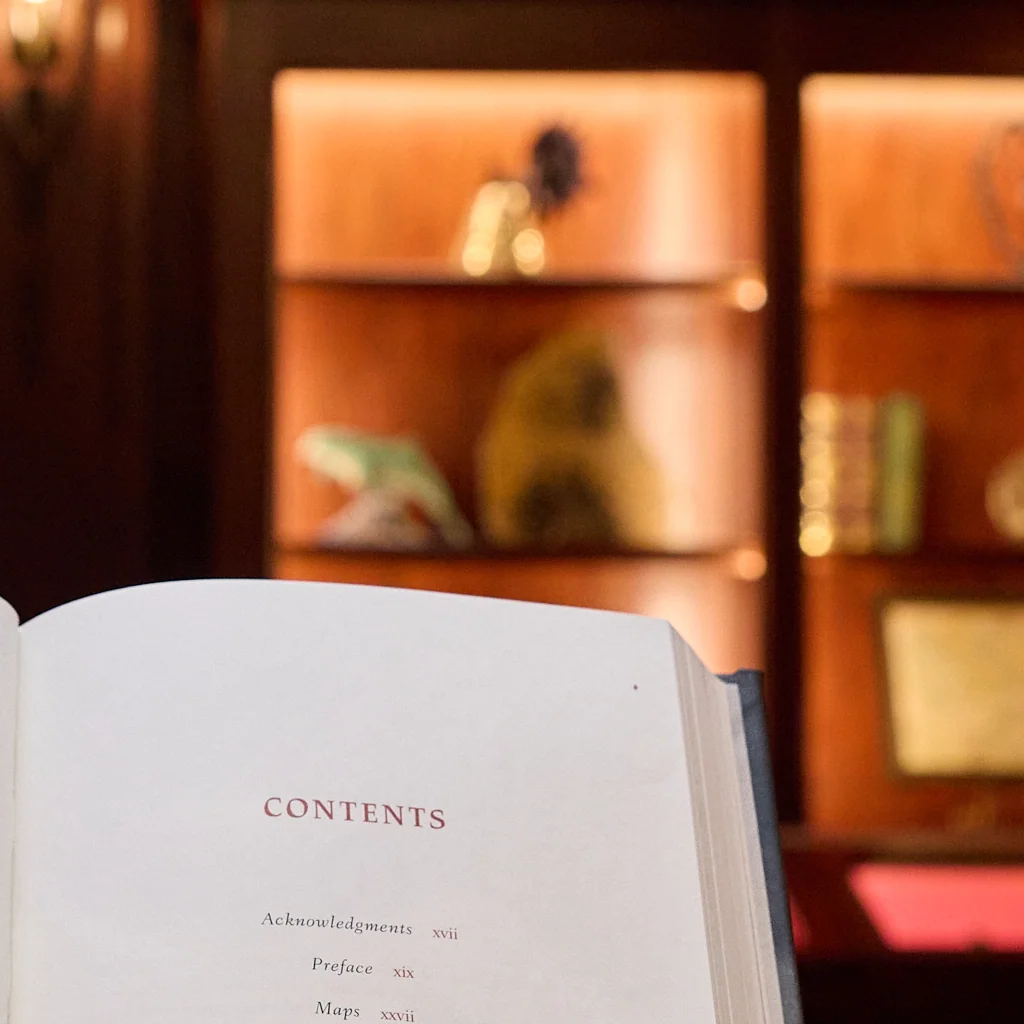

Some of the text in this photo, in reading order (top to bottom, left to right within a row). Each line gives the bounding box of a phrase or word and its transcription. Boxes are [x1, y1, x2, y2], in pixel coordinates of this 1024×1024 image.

[263, 796, 446, 830] CONTENTS
[261, 912, 458, 940] Acknowledgments xvii
[312, 957, 415, 979] Preface xix
[315, 1001, 415, 1023] Maps xxvii
